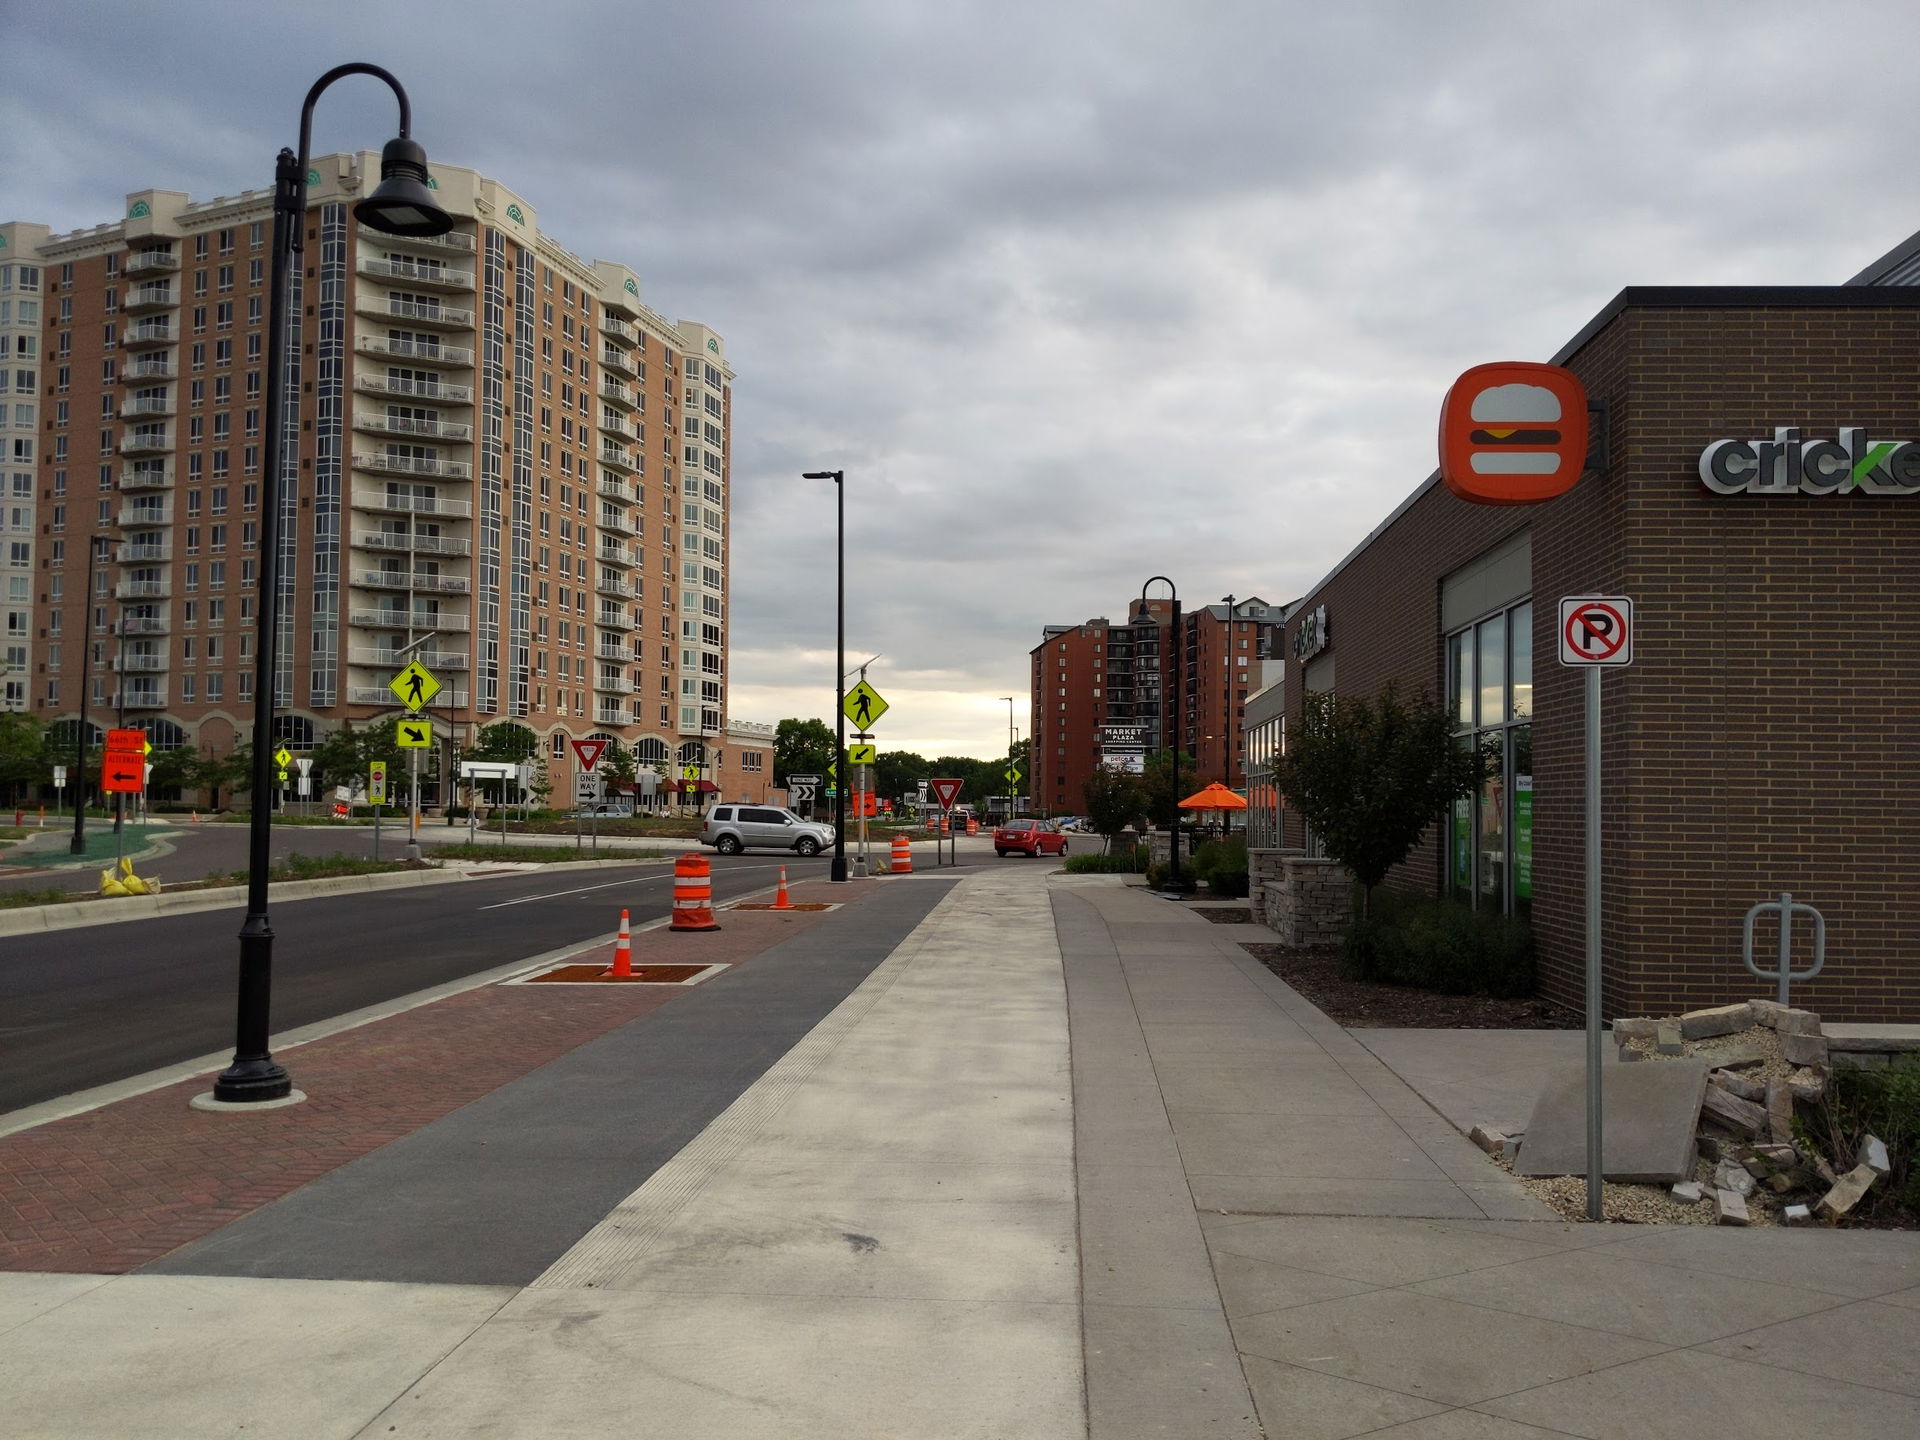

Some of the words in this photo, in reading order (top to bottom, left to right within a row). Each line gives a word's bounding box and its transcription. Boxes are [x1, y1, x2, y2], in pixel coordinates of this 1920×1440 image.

[1699, 427, 1920, 494] cricke
[1583, 613, 1613, 649] P
[580, 774, 596, 782] ONE
[1455, 799, 1470, 819] FREE
